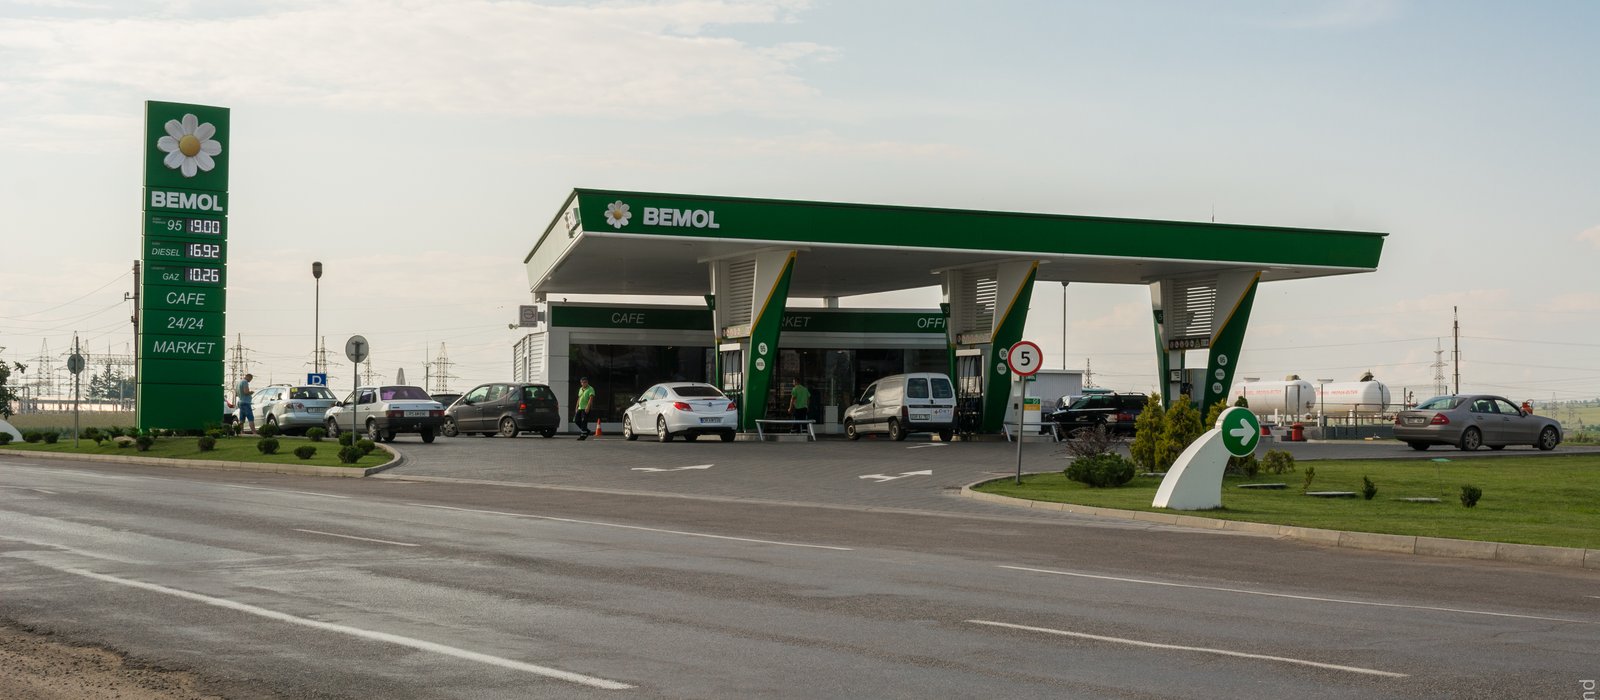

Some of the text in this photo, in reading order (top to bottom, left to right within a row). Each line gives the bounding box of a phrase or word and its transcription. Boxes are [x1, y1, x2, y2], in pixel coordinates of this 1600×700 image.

[151, 190, 223, 212] BEMOL
[643, 207, 720, 229] BEMOL
[167, 219, 183, 231] 95
[190, 219, 220, 234] 19.00
[151, 243, 220, 259] DIESEL 16.92
[162, 268, 219, 283] GAZ 10.26
[166, 292, 206, 306] CAFE
[167, 316, 205, 330] 24/24
[611, 312, 645, 325] CAFE
[153, 340, 216, 355] MARKET
[1020, 351, 1031, 366] 5
